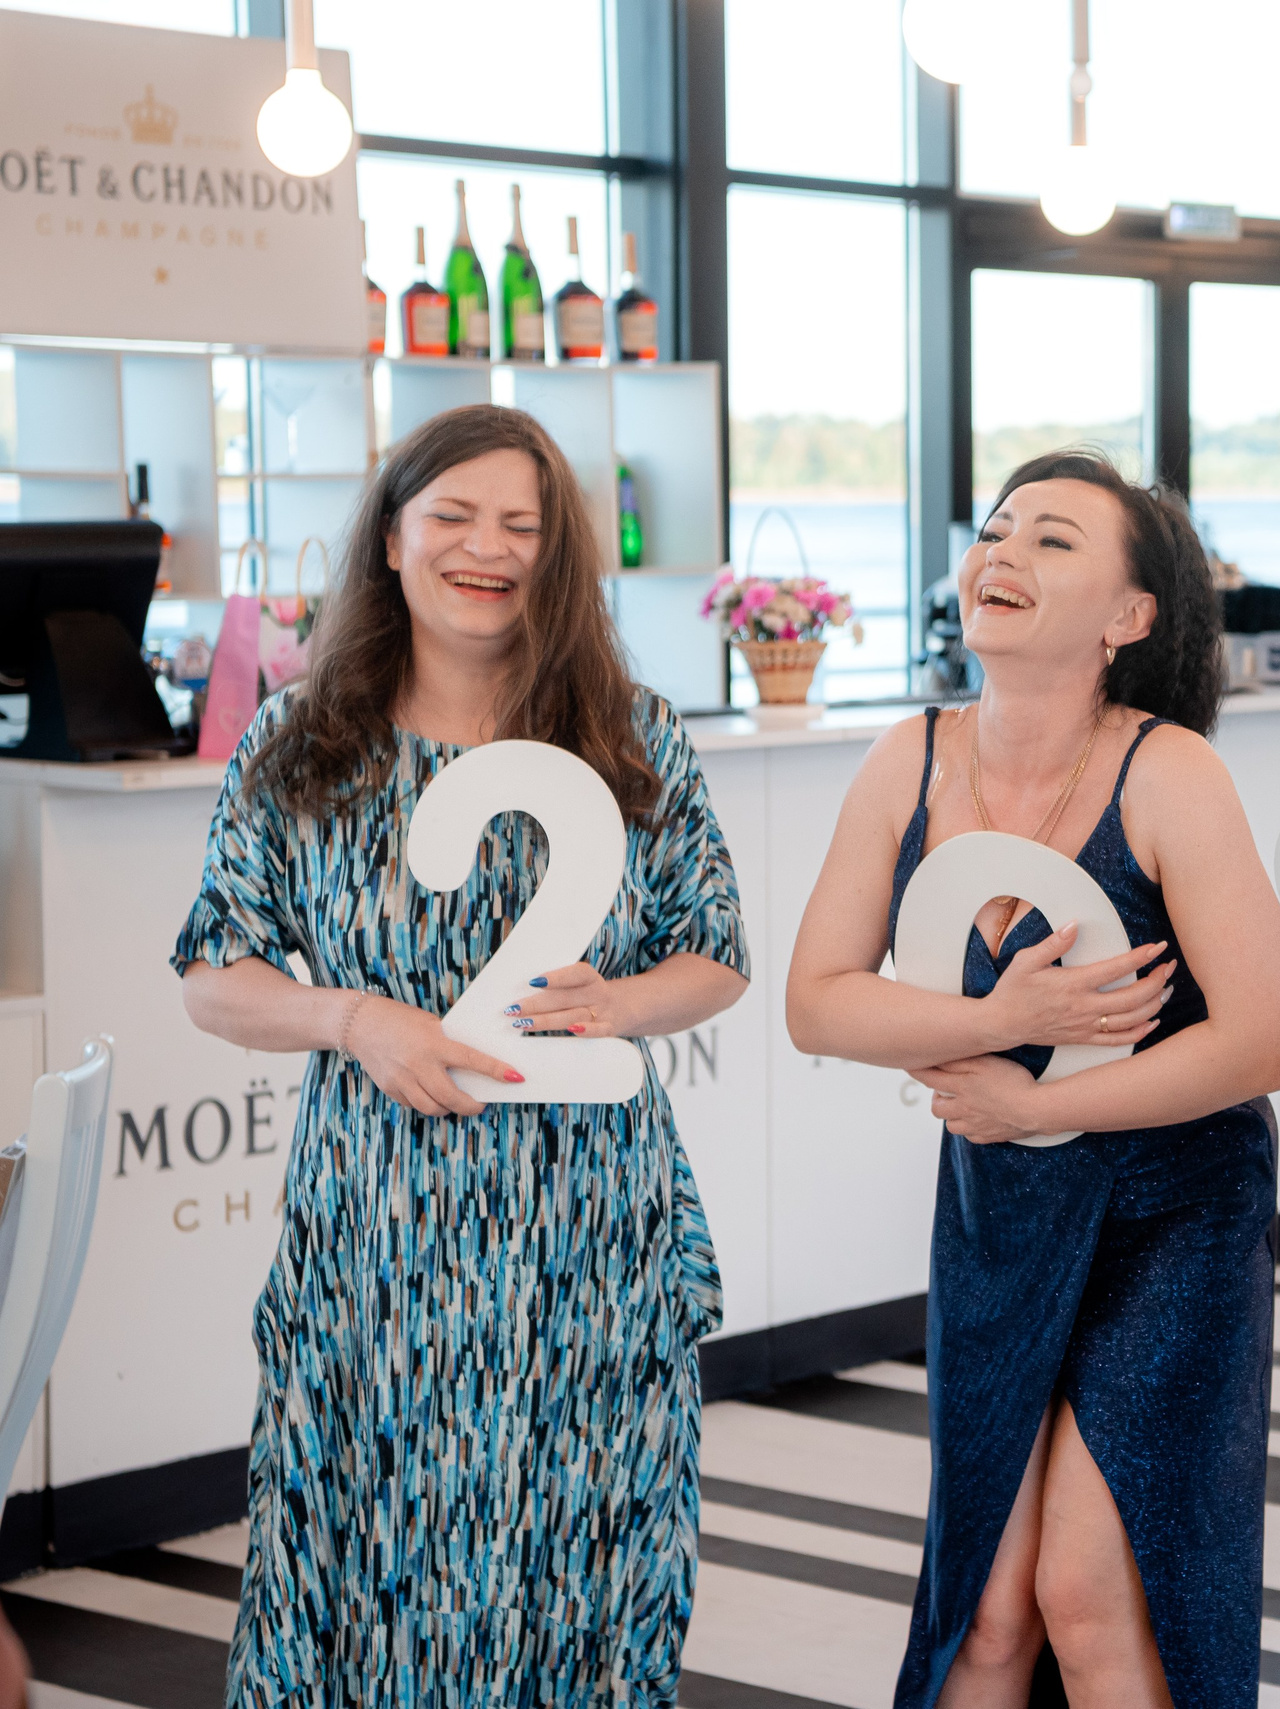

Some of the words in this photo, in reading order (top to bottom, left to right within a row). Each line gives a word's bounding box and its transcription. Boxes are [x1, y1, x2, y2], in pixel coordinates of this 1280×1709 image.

[130, 160, 335, 214] CHANDON
[35, 213, 269, 250] CHAMPAGNE
[114, 1078, 302, 1179] MOË
